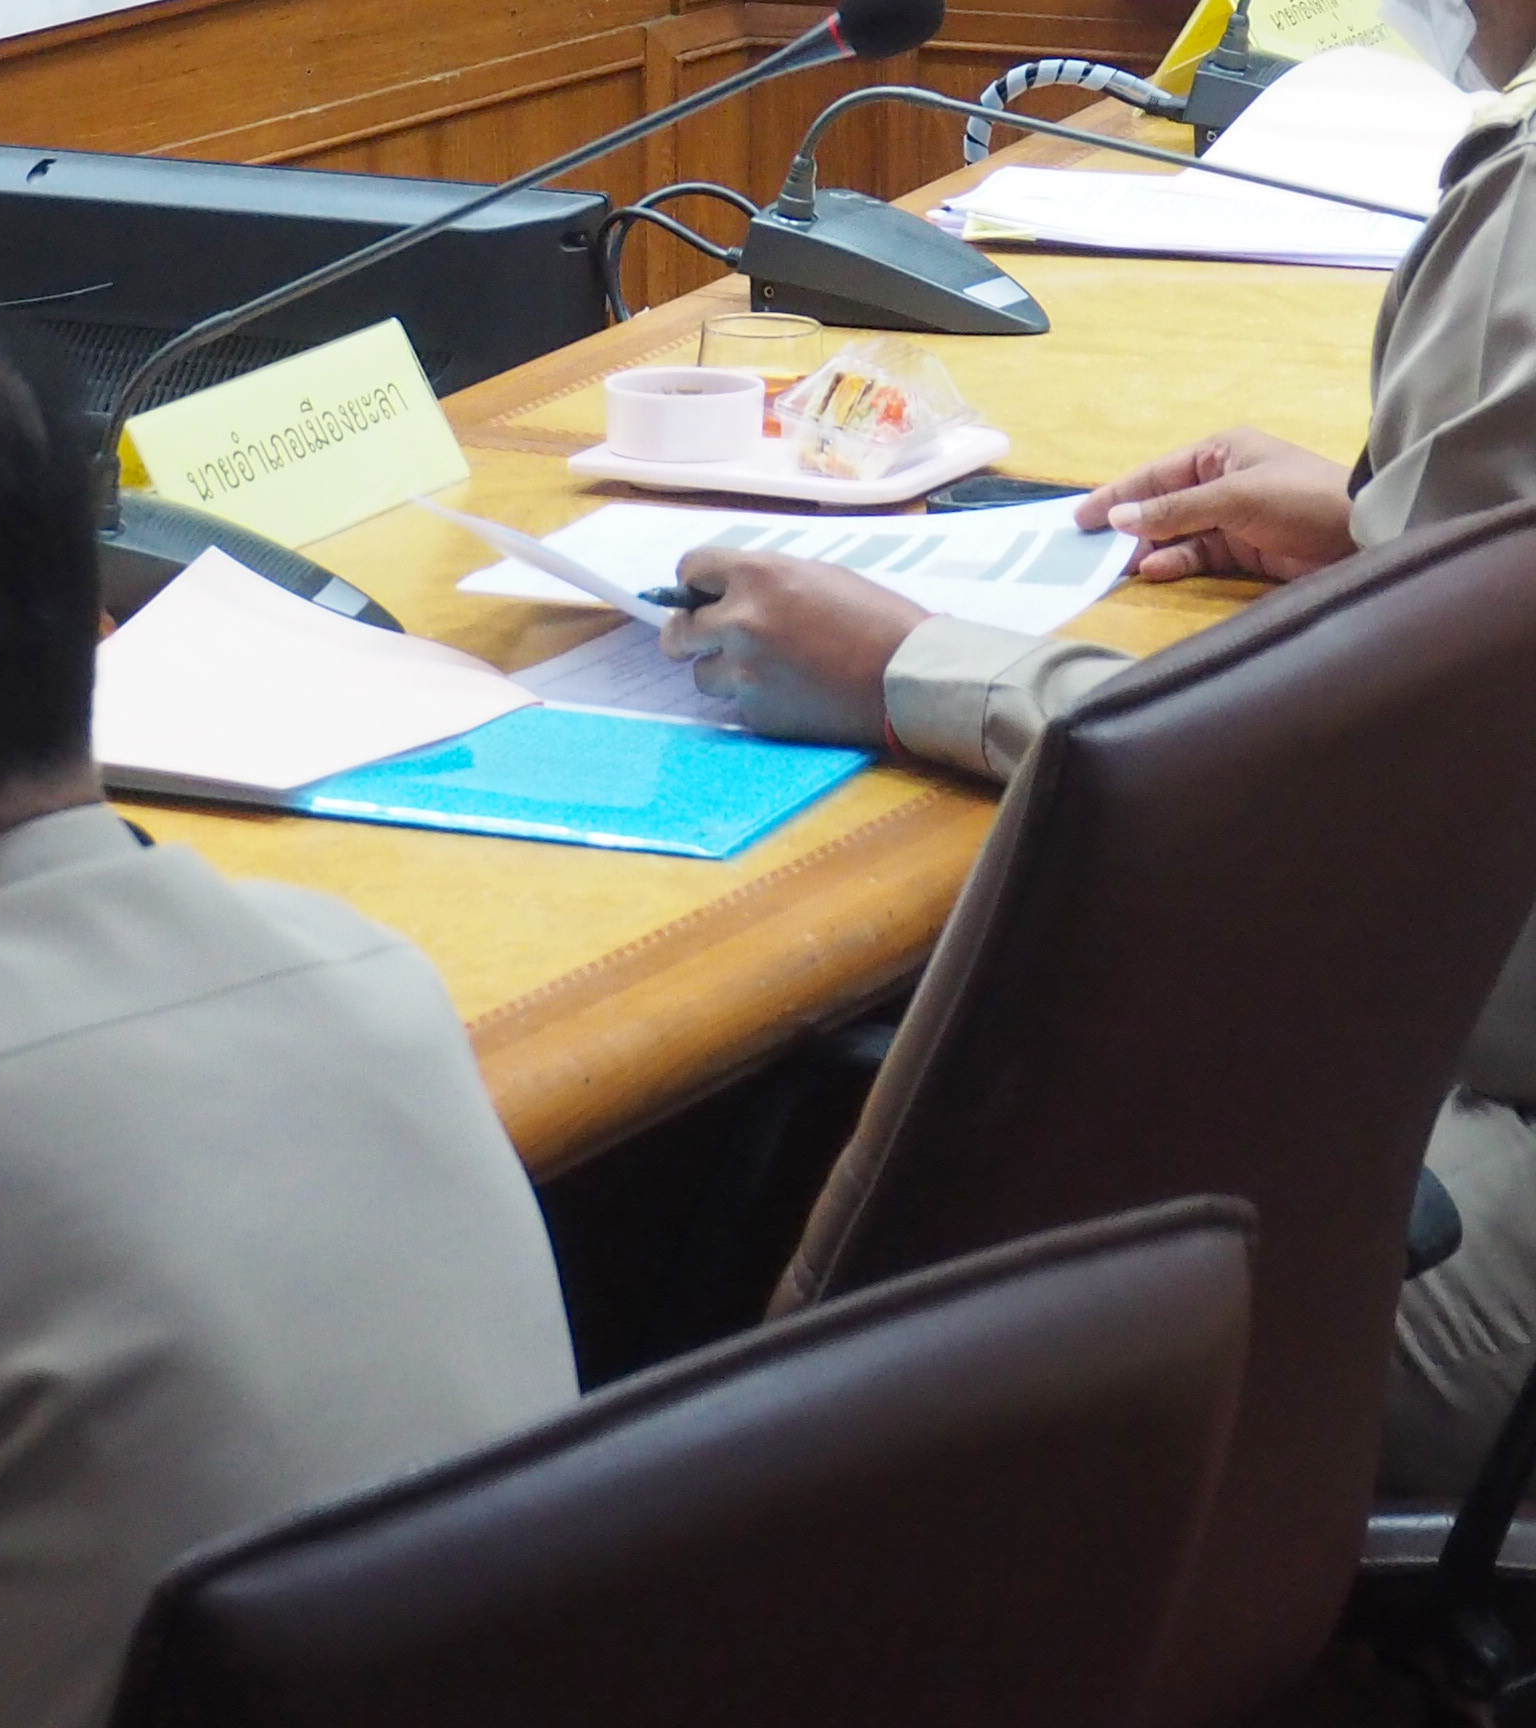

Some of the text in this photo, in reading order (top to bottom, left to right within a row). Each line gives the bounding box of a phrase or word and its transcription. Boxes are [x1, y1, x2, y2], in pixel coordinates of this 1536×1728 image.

[186, 381, 409, 503] นายอำเภอเมืองยะลา
